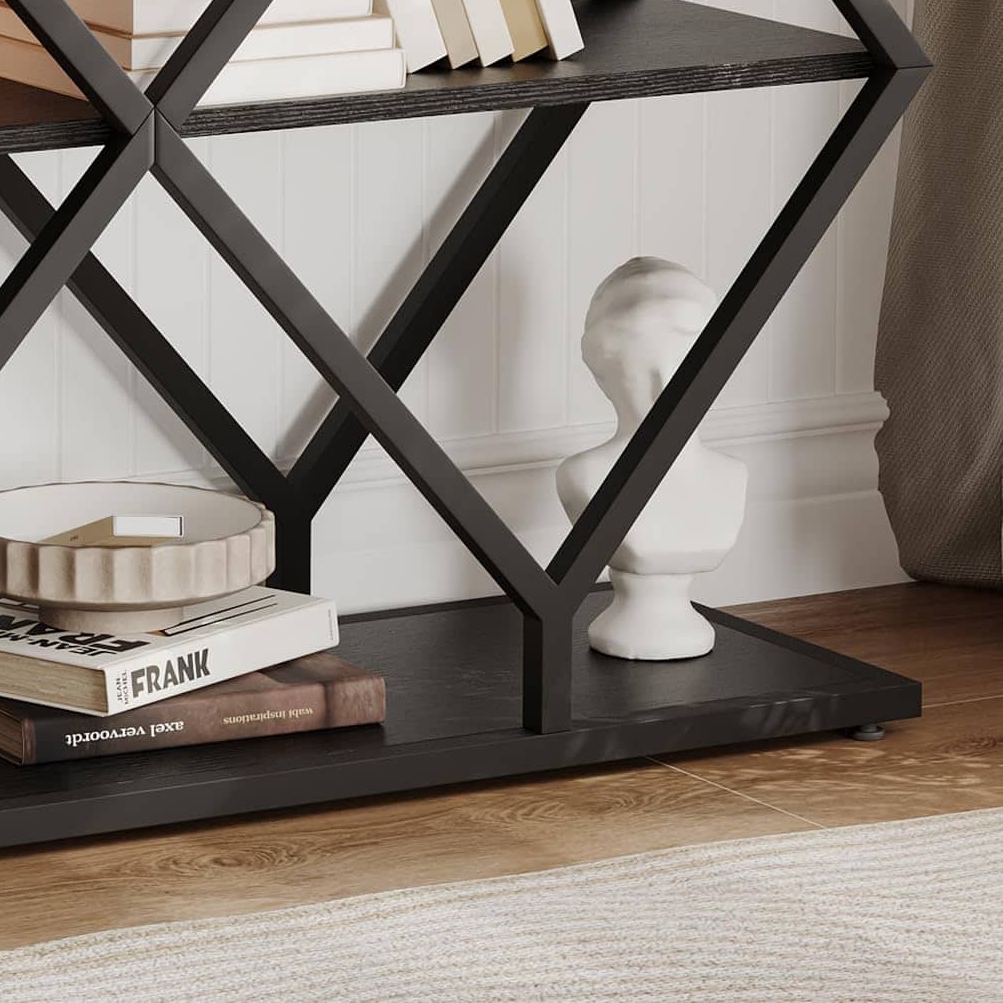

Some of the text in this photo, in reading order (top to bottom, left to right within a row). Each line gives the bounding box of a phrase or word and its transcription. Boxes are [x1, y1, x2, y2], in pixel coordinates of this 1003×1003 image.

[121, 669, 129, 705] MICHEL
[130, 648, 210, 699] FRANK
[115, 678, 123, 701] JEAN
[222, 707, 314, 726] wabi inspirations
[65, 720, 184, 747] axel vervoordt
